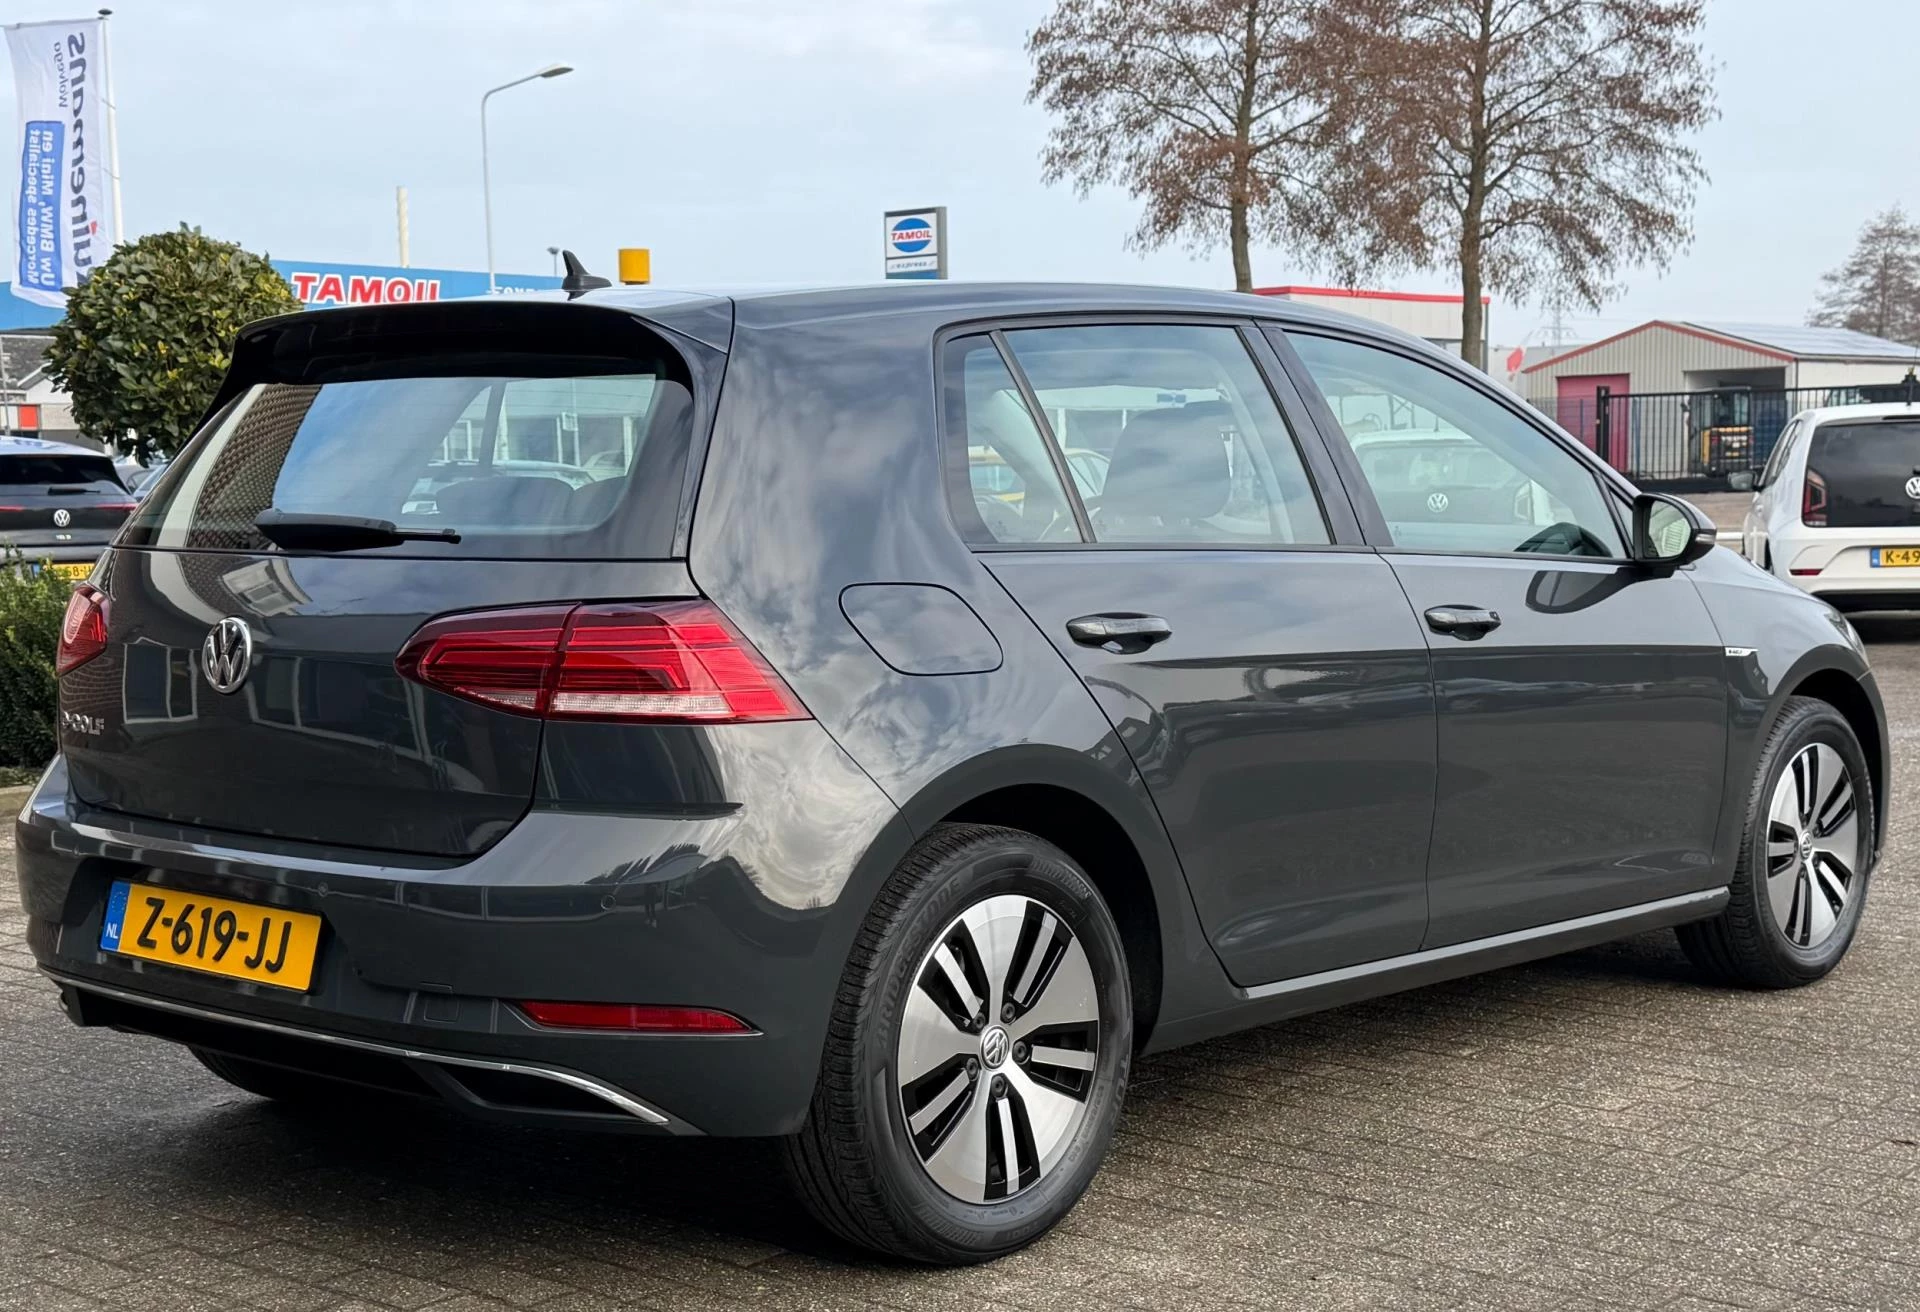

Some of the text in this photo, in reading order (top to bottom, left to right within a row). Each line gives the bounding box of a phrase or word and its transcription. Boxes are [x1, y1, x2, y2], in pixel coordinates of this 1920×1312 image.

[891, 230, 933, 241] TAMOIL
[105, 922, 120, 939] NL
[136, 896, 293, 974] Z-619-JJ
